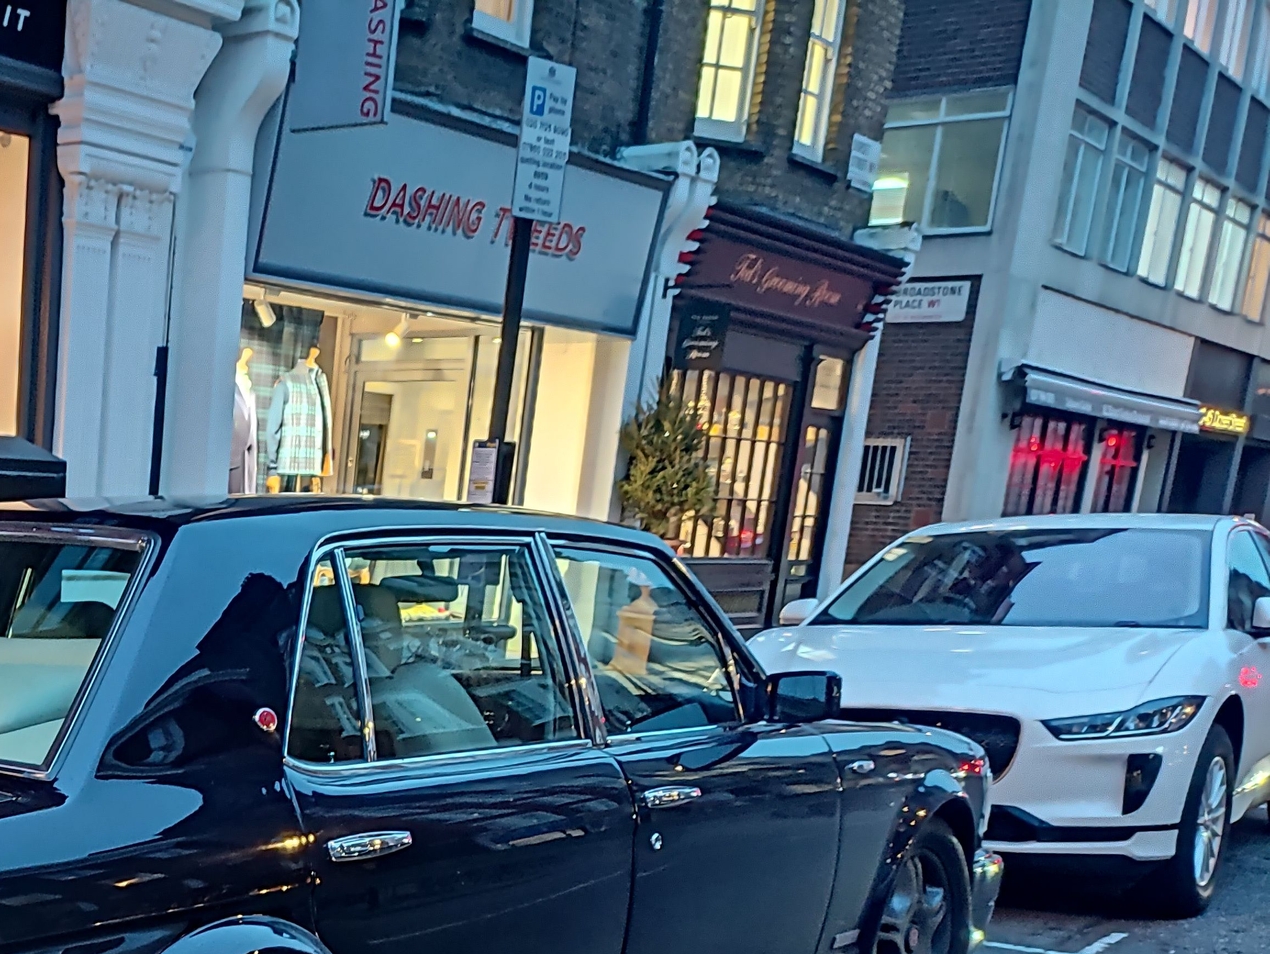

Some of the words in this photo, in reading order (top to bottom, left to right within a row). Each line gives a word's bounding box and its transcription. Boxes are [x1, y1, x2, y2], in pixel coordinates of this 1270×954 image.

[360, 0, 388, 118] ASHING
[364, 177, 485, 239] DASHING
[491, 207, 586, 258] TEEDS
[893, 299, 924, 310] PLACE
